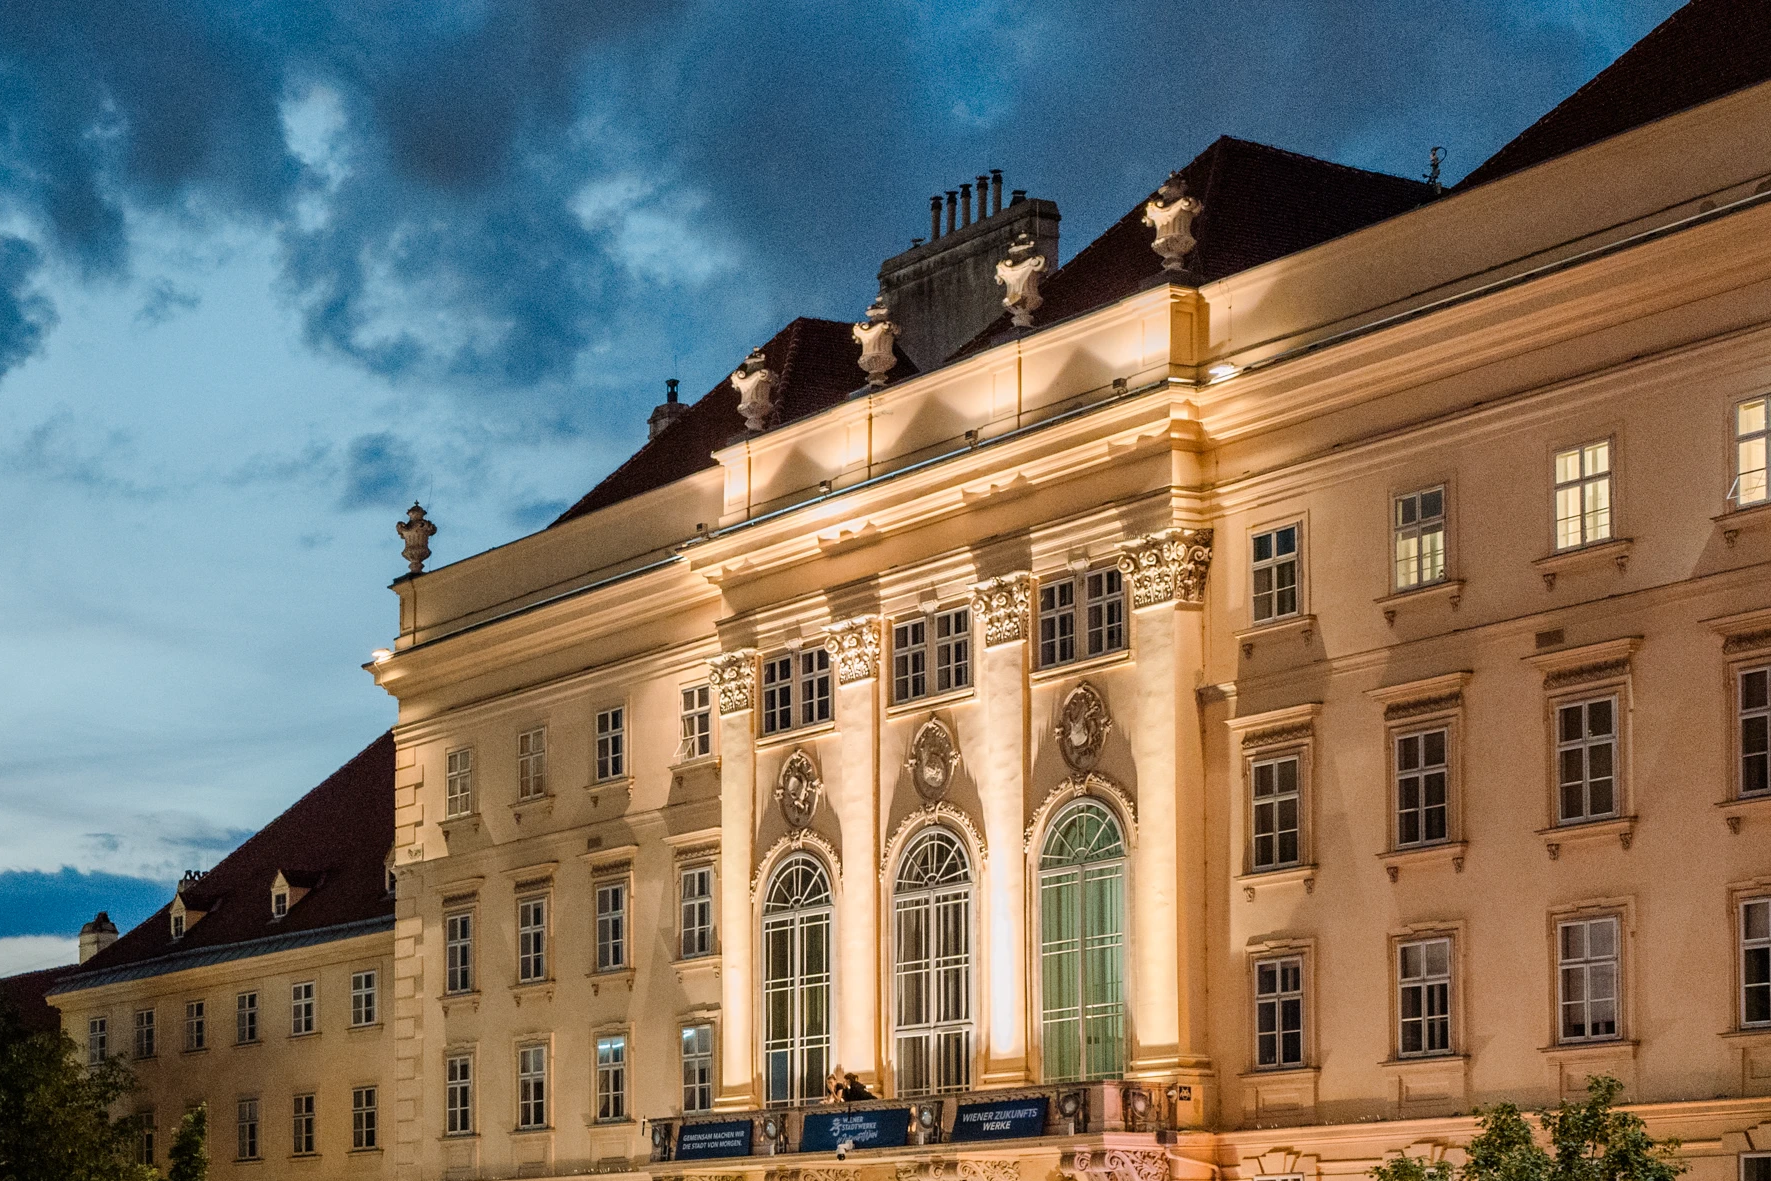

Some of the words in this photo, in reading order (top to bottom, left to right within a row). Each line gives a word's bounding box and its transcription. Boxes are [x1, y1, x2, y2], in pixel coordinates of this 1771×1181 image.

[962, 1112, 994, 1122] WIENER
[994, 1108, 1038, 1120] ZUKUNFTS
[841, 1122, 877, 1131] STADTWERKE
[982, 1121, 1011, 1131] WERKE
[682, 1133, 713, 1141] GEMEINSAM
[713, 1131, 735, 1139] MACHEN
[682, 1142, 691, 1150] DIE
[691, 1141, 707, 1149] STADT
[707, 1140, 719, 1148] VON
